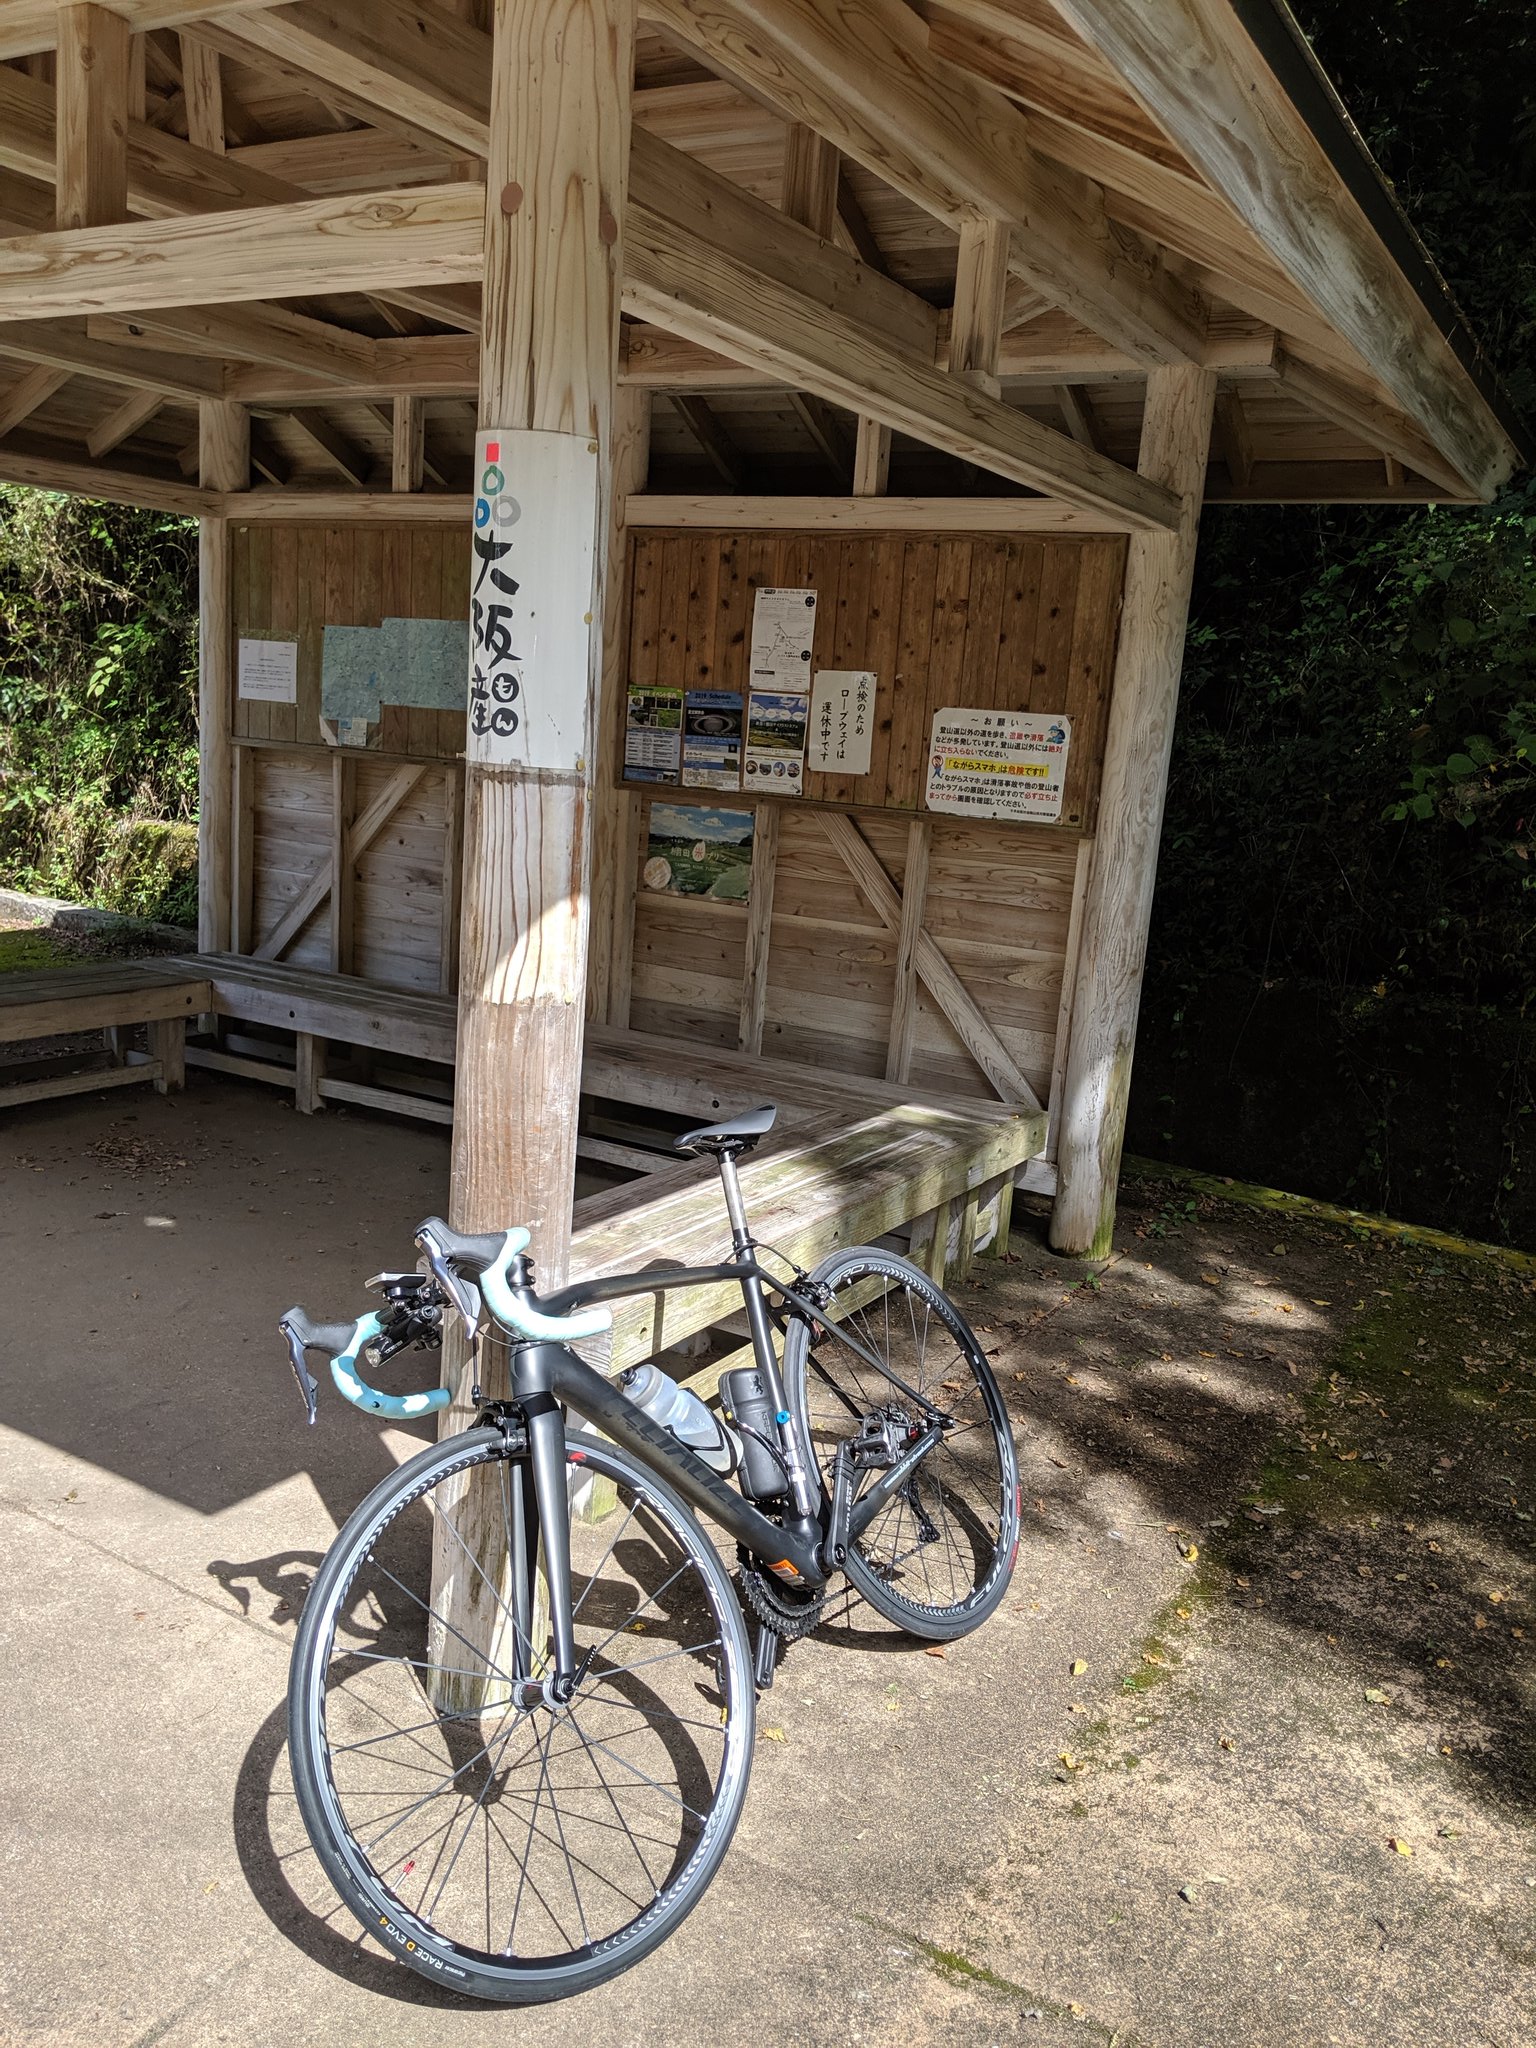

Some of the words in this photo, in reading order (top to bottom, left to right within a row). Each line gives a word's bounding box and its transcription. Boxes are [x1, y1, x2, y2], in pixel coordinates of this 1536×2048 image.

[855, 676, 869, 736] 点検のため
[820, 701, 833, 762] 運休中です
[837, 690, 850, 760] ロープウェイは
[378, 1914, 389, 1928] 4
[385, 1922, 406, 1944] EVO
[405, 1939, 416, 1952] D
[414, 1946, 443, 1969] RACE
